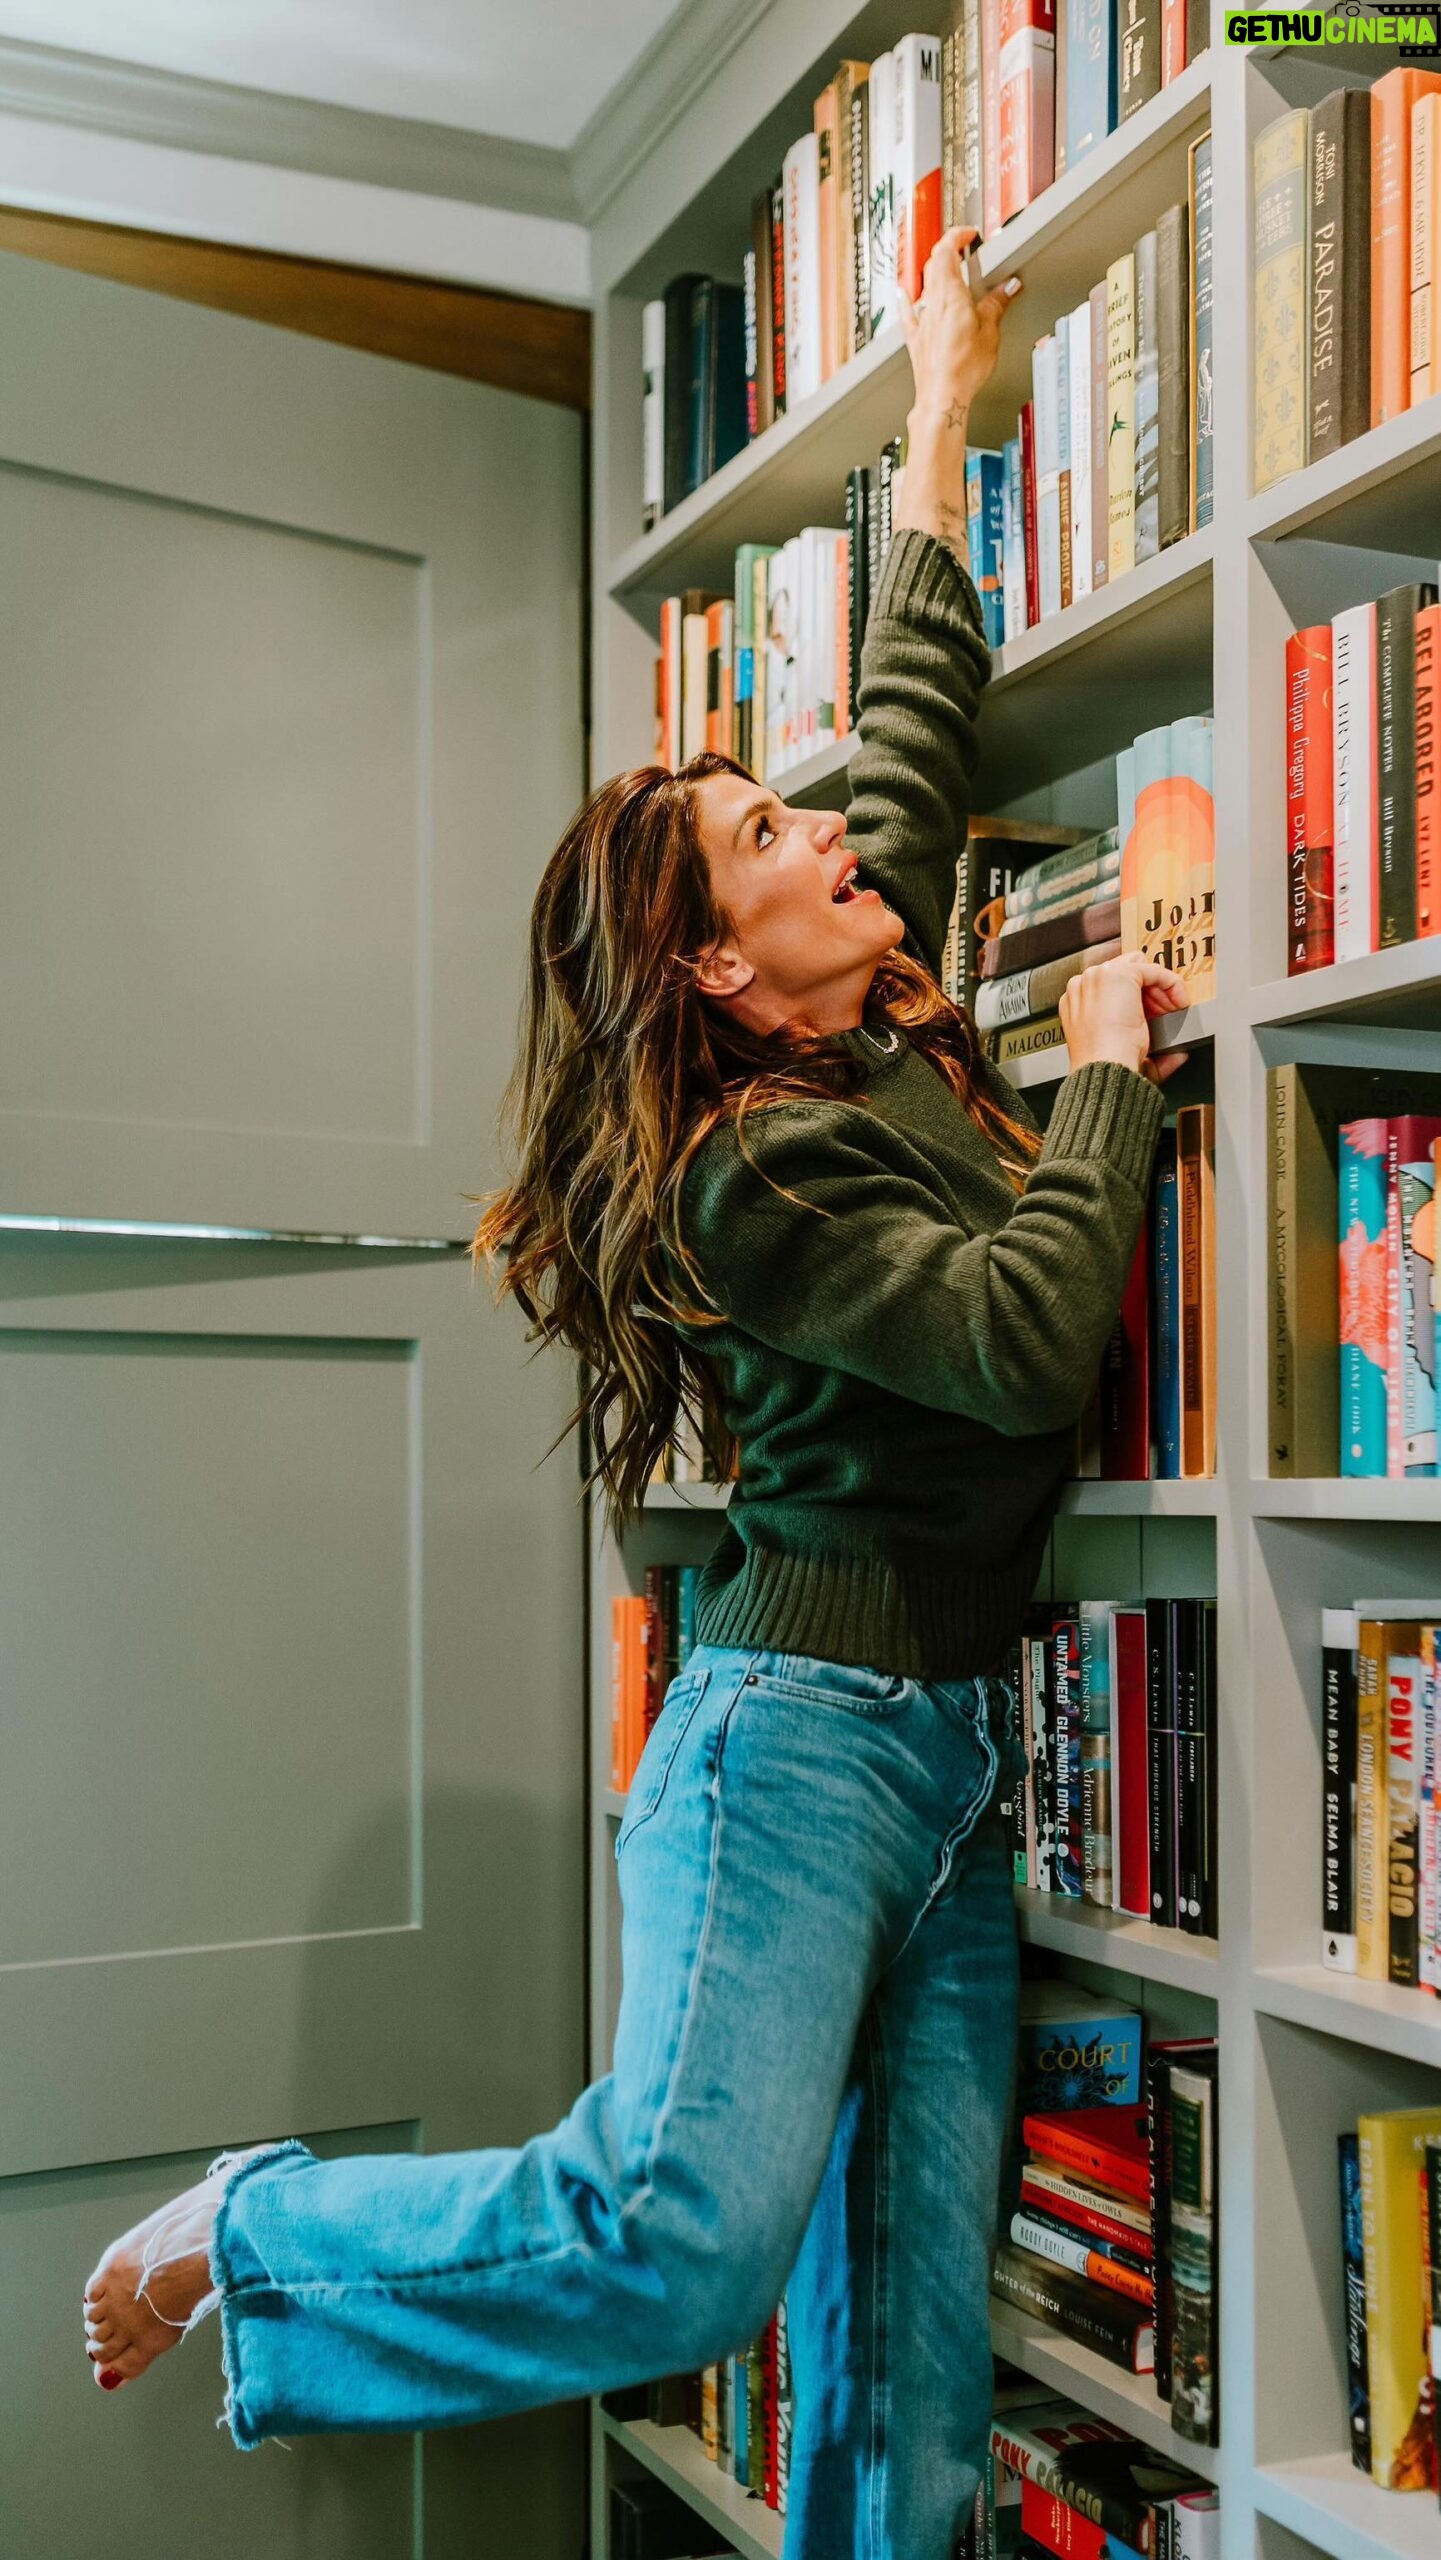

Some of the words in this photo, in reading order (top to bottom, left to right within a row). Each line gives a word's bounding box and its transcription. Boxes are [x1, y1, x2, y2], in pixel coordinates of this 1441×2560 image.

[1314, 131, 1327, 206] MORRISON
[1325, 143, 1336, 178] TONI
[1415, 144, 1425, 193] JEKYLL
[1415, 241, 1425, 278] HYDE
[1113, 282, 1119, 292] A
[1313, 221, 1335, 377] PARADISE
[1058, 397, 1067, 460] CLOUD
[1061, 480, 1070, 523] ANNIE
[1061, 531, 1071, 591] PROULX
[1337, 634, 1349, 693] BILL
[1382, 645, 1393, 723] COMPLETE
[1290, 668, 1310, 732] Philippa
[1415, 626, 1433, 797] BELABORED
[1290, 737, 1310, 799] Gregory
[1337, 702, 1350, 806] BRYSON
[1383, 726, 1393, 772] NOTES
[1383, 796, 1394, 820] Bill
[1293, 813, 1306, 868] DARK
[1383, 825, 1394, 873] Bryson
[1294, 873, 1306, 927] TIDES
[1274, 1084, 1286, 1129] JOHN
[1275, 1135, 1286, 1181] CAGE
[1350, 1166, 1359, 1191] THE
[1389, 1136, 1398, 1182] JENNY
[1275, 1208, 1286, 1219] A
[1350, 1197, 1359, 1228] NEW
[1388, 1193, 1398, 1251] MOLLEN
[1186, 1249, 1196, 1298] Wilson
[1275, 1225, 1287, 1344] MYCOLOGICAL
[1388, 1269, 1398, 1316] CITY
[1276, 1353, 1288, 1410] FORAY
[1351, 1347, 1360, 1389] DIANE
[1082, 1614, 1093, 1650] Little
[1057, 1635, 1068, 1704] UNTAMED
[1082, 1655, 1093, 1723] Monsters
[1326, 1669, 1339, 1720] MEAN
[1367, 1659, 1377, 1695] SARAH
[1389, 1677, 1413, 1762] PONY
[1057, 1715, 1068, 1783] GLENNON
[1326, 1728, 1339, 1774] BABY
[1359, 1733, 1374, 1794] LONDON
[1057, 1788, 1068, 1835] DOYLE
[1083, 1767, 1094, 1832] Adrienne
[1326, 1792, 1339, 1851] SELMA
[1083, 1834, 1094, 1893] Brodeur
[1389, 1778, 1414, 1919] PALACIO
[1326, 1857, 1339, 1911] BLAIR
[1359, 1860, 1375, 1924] SOCIETY
[1040, 2042, 1131, 2071] COURT
[1361, 2139, 1373, 2201] BORN
[1050, 2181, 1077, 2201] HIDDEN
[1077, 2189, 1098, 2209] LIVES
[1102, 2200, 1122, 2219] OWLS
[1362, 2208, 1374, 2237] TO
[1020, 2225, 1042, 2246] RODDY
[1044, 2237, 1065, 2260] DOYLE
[1363, 2244, 1378, 2314] SHINE
[1035, 2292, 1060, 2313] REICH
[1064, 2308, 1093, 2331] LOUISE
[1094, 2325, 1115, 2341] FEIN
[1347, 2263, 1366, 2369] Starlings
[992, 2430, 1032, 2477] PONY
